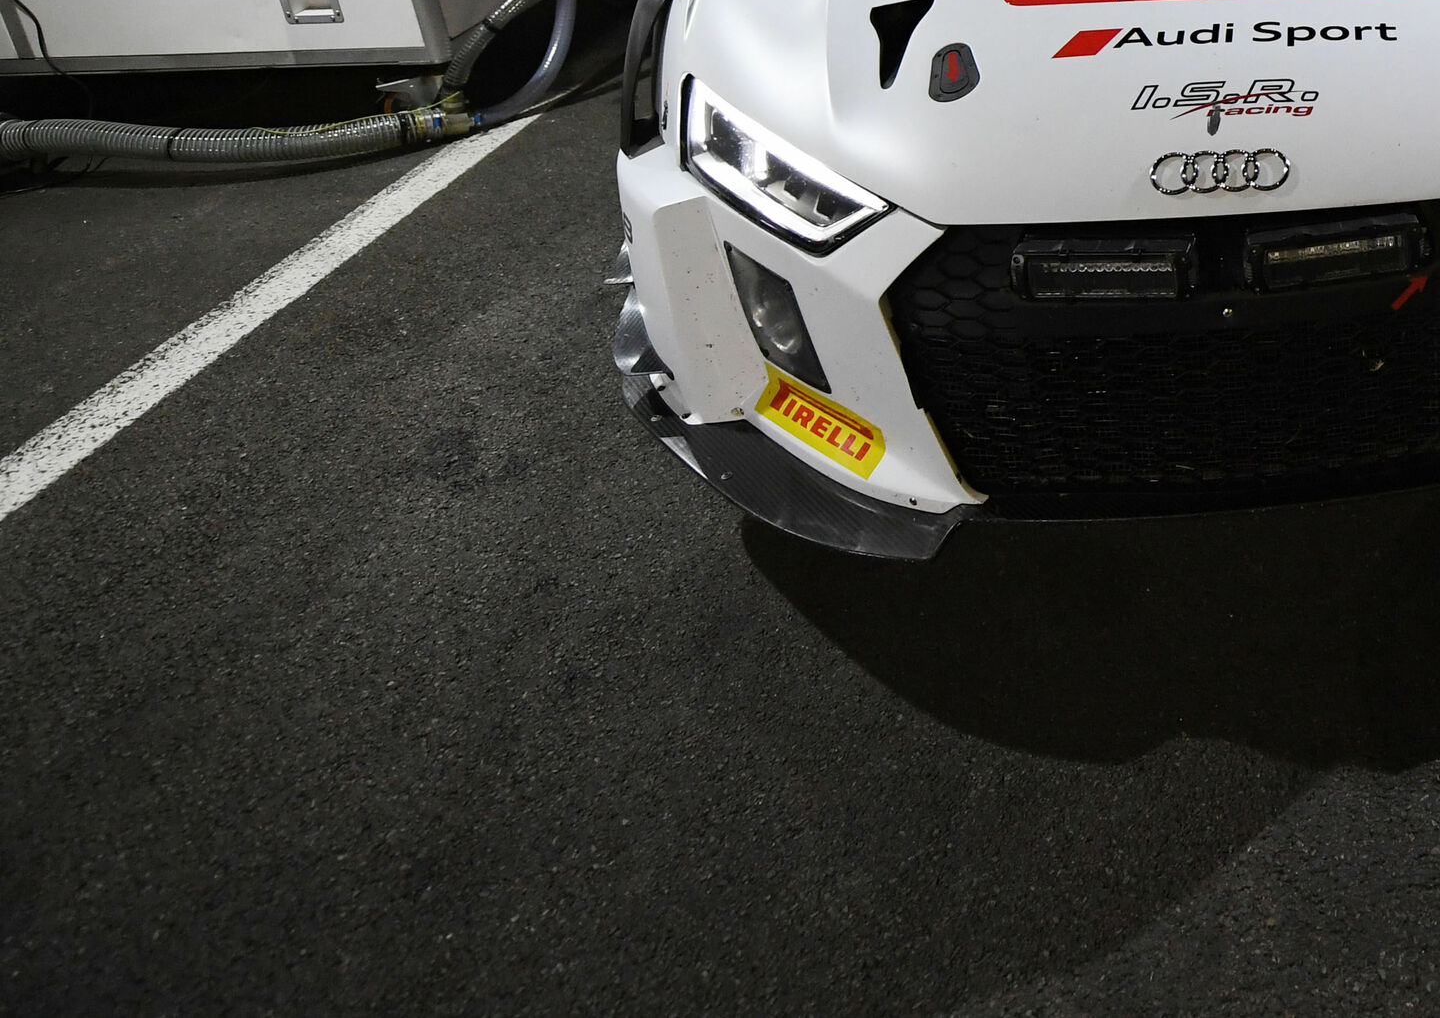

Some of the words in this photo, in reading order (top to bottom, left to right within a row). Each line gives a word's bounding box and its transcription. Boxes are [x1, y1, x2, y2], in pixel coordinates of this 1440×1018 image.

[1113, 23, 1235, 48] Audi
[1252, 22, 1398, 46] Sport
[1131, 78, 1320, 111] I.S.R.
[1207, 103, 1314, 118] racing
[769, 377, 875, 462] PIRELLI
